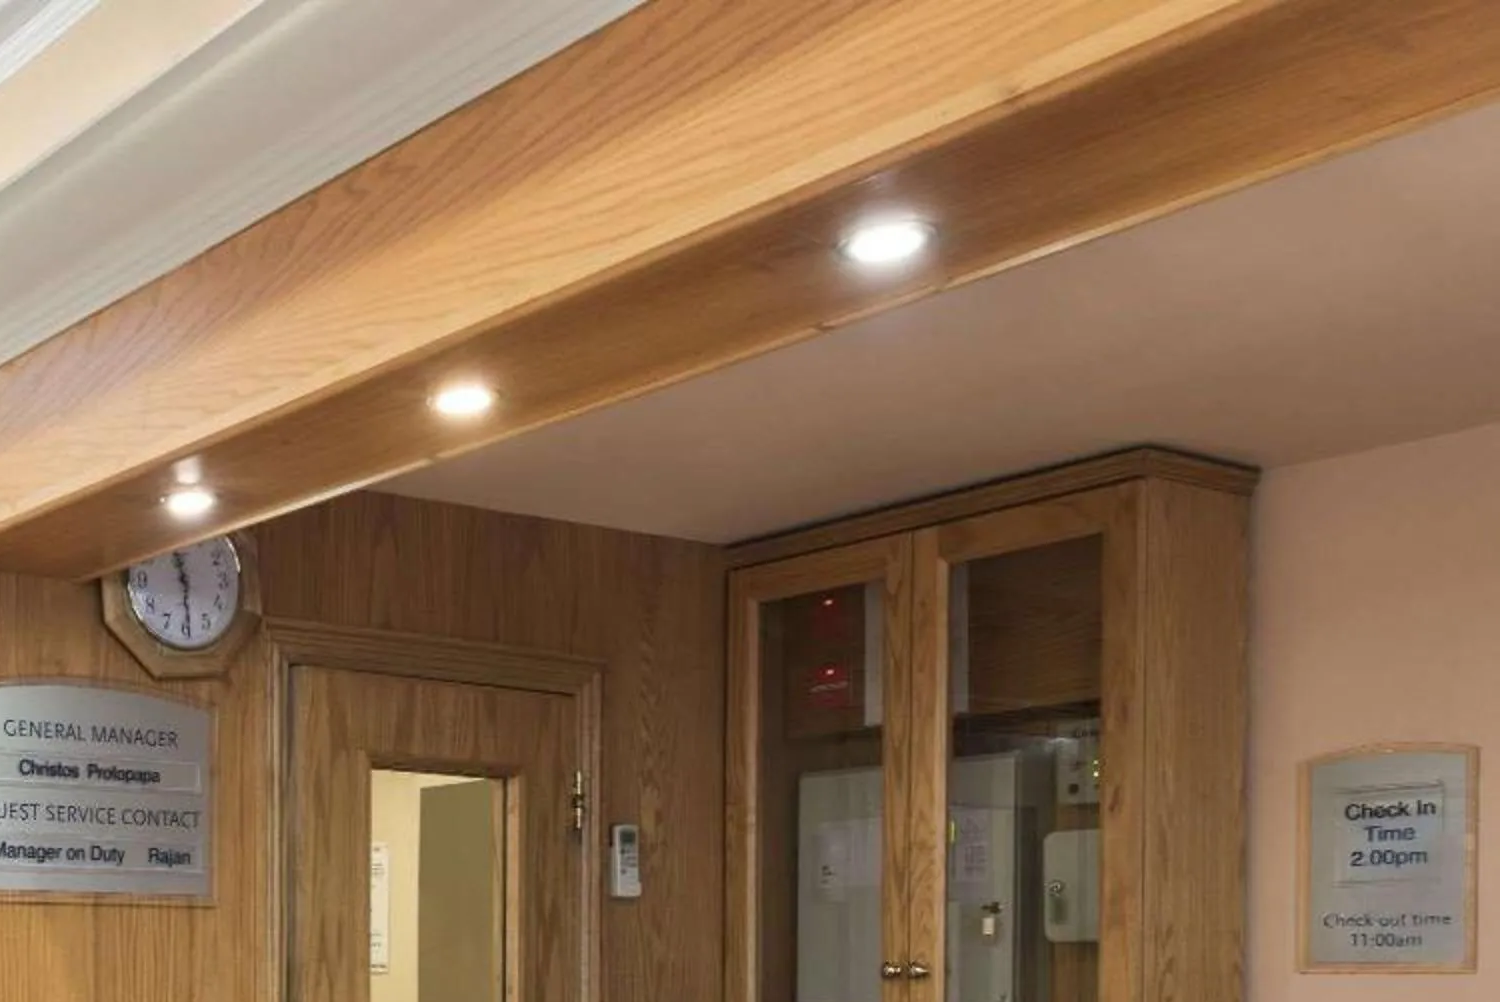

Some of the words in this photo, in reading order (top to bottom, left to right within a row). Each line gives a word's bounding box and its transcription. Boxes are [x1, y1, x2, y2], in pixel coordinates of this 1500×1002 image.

[3, 719, 86, 742] GENERAL
[91, 725, 179, 748] MANAGER
[18, 758, 80, 780] Christos
[45, 805, 116, 825] SERVICE
[120, 808, 200, 829] CONTACT
[1344, 801, 1410, 822] Check
[1416, 799, 1437, 816] In
[1363, 825, 1417, 842] Time
[65, 846, 86, 862] on
[90, 845, 126, 867] Duty
[147, 848, 192, 868] Rajan
[1412, 913, 1453, 926] time
